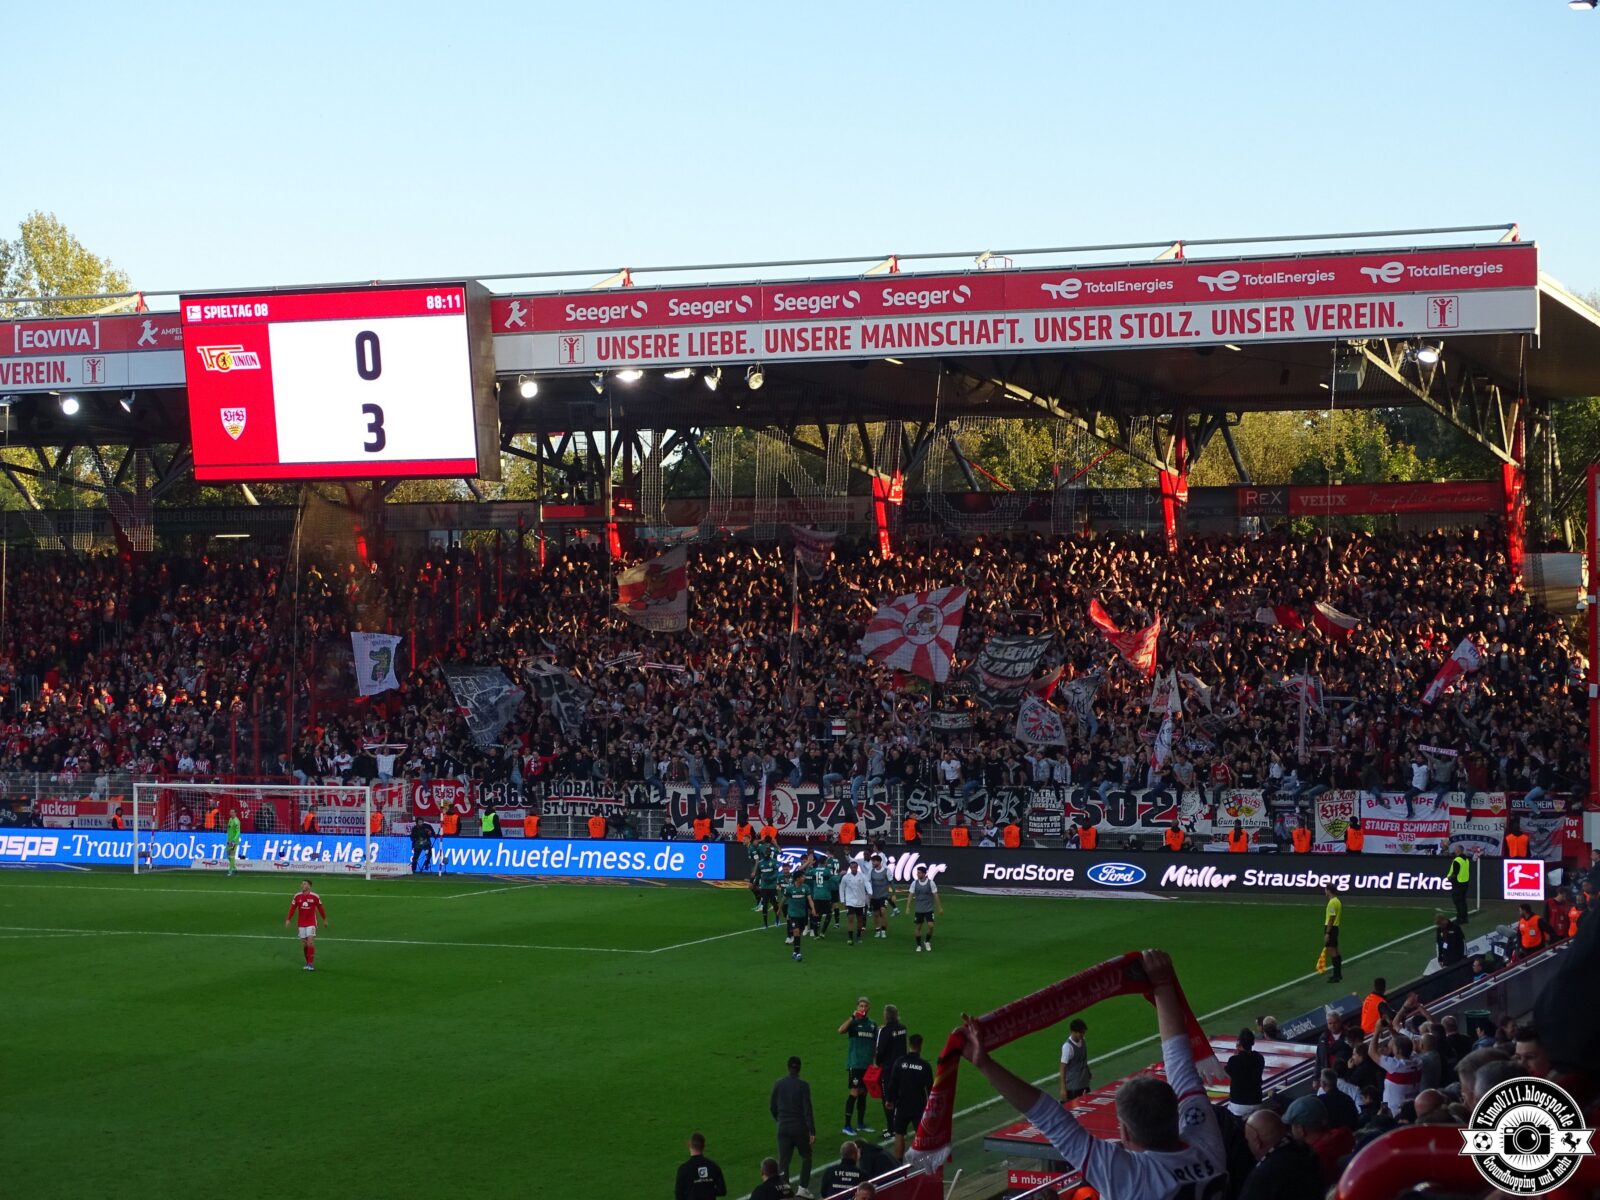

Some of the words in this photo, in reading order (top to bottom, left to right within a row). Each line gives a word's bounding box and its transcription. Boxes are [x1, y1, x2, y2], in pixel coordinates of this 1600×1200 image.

[1243, 270, 1336, 287] TotalEnergies
[1407, 262, 1504, 279] TotalEnergies
[1085, 278, 1174, 296] TotalEnergies
[426, 295, 462, 309] 88:11
[773, 294, 841, 315] Seeger
[882, 288, 950, 309] Seeger
[204, 305, 252, 319] SPIELTAG
[254, 303, 268, 316] 08
[565, 303, 629, 324] Seeger
[668, 298, 734, 319] Seeger
[161, 327, 183, 337] AMPEL
[596, 334, 679, 361] UNSERE
[688, 331, 755, 356] LIEBE.
[765, 326, 852, 354] UNSERE
[862, 316, 1023, 350] MANNSCHAFT.
[1034, 315, 1113, 343] UNSER
[1120, 310, 1201, 339] STOLZ.
[1211, 305, 1294, 336] UNSER
[1304, 299, 1404, 331] VEREIN.
[233, 354, 258, 368] UNION
[356, 331, 381, 381] 0
[0, 361, 71, 385] VEREIN.
[362, 403, 386, 453] 3
[1246, 491, 1283, 505] REX
[1300, 495, 1347, 507] VELUX
[1393, 795, 1449, 811] WMPFN
[1451, 793, 1485, 805] Glms
[1512, 800, 1553, 809] OSTEHEIM
[40, 802, 77, 817] uckau
[543, 803, 625, 818] STUTTGART
[334, 816, 368, 825] CROCODIL
[1365, 820, 1400, 833] STAUFER
[1402, 822, 1448, 835] SCHWABEN
[1451, 821, 1490, 832] Inferno
[1565, 818, 1579, 827] Tor
[1565, 831, 1577, 839] 14
[1311, 843, 1333, 852] NAU
[431, 842, 685, 874] www.huetel-mess.de
[983, 863, 1075, 882] FordStore
[1097, 866, 1134, 884] Ford
[1161, 864, 1237, 888] Müller
[1243, 869, 1351, 893] Strausberg
[1355, 872, 1397, 890] und
[1399, 872, 1453, 891] Erkne
